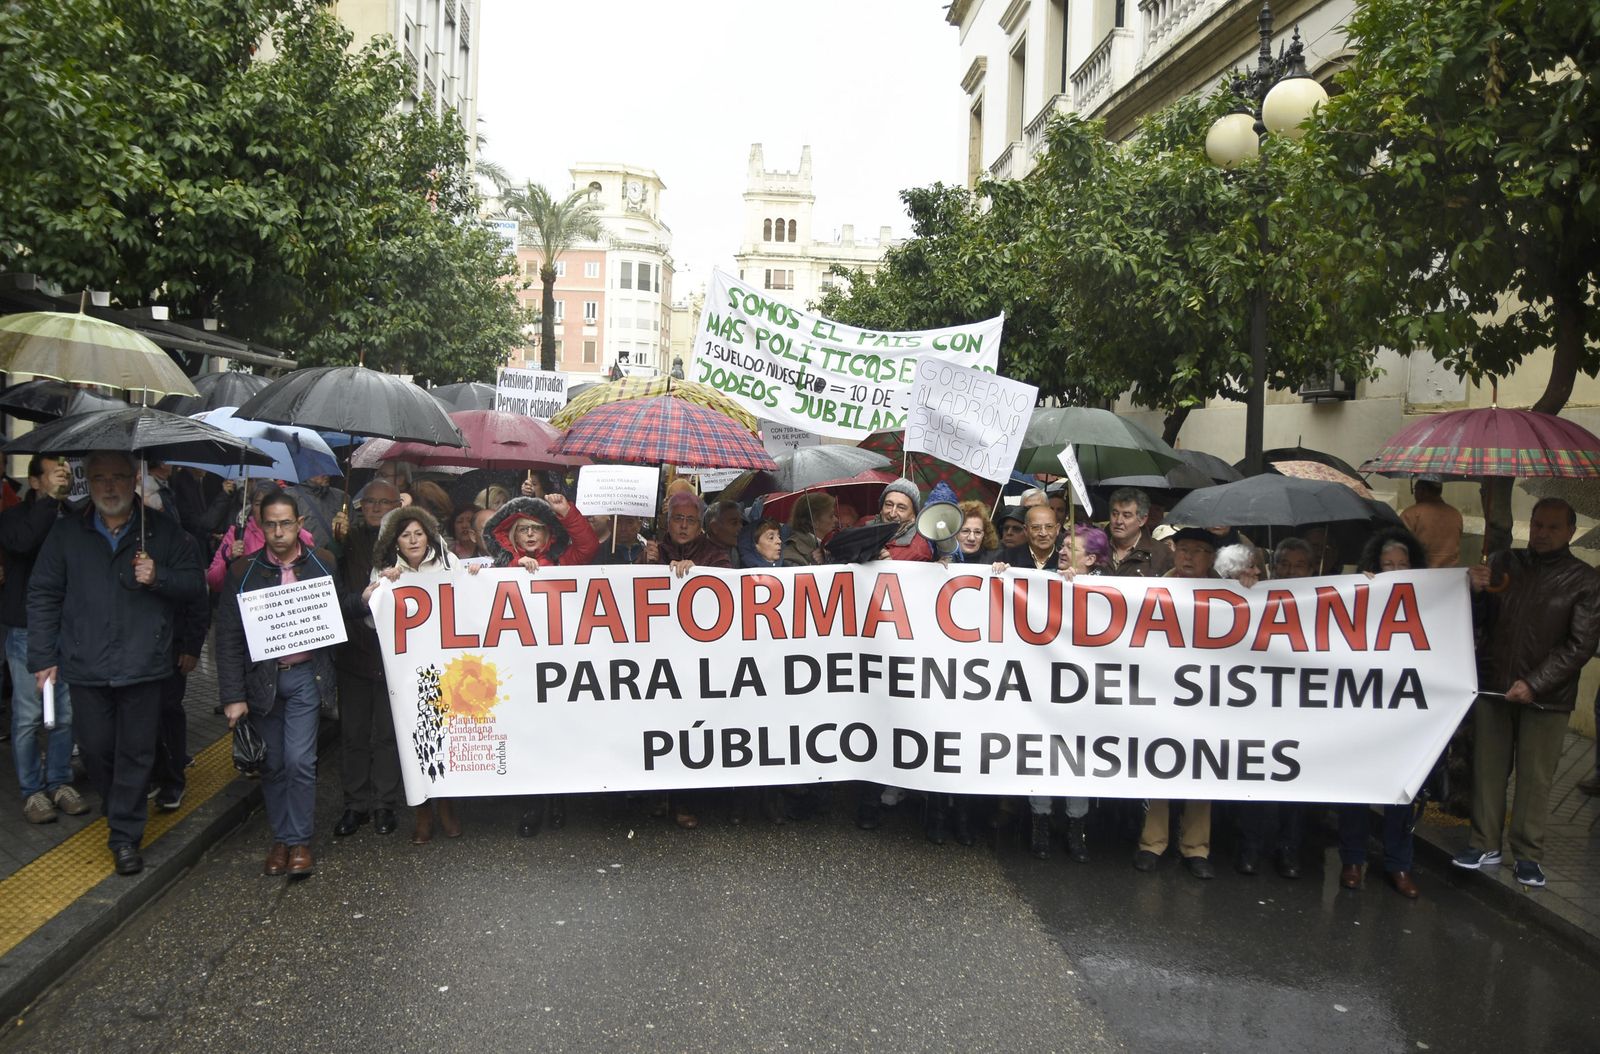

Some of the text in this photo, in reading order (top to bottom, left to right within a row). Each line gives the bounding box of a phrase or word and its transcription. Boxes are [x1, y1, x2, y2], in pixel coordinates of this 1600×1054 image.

[706, 311, 747, 344] MÁS
[728, 287, 983, 353] SOMOS EL PAIS CON
[498, 370, 564, 393] Pensiones privadas
[920, 360, 1029, 413] GOBIERNO
[497, 392, 561, 418] Personas estafadas
[850, 384, 868, 403] 10
[872, 388, 895, 408] DE
[914, 407, 1009, 454] SUBE LA
[242, 579, 333, 604] POR NEGLIGENCIA MÉDICA
[284, 597, 294, 605] DE
[296, 592, 320, 603] VISIÓN
[321, 590, 331, 598] EN
[257, 602, 328, 622] OJO LA SEGURIDAD
[391, 571, 1431, 655] PLATAFORMA CIUDADANA
[265, 624, 330, 643] HACE CARGO DEL
[270, 621, 298, 631] SOCIAL
[299, 617, 311, 625] NO
[264, 633, 336, 654] DAÑO OCASIONADO
[535, 652, 1429, 710] PARA LA DEFENSA DEL SISTEMA
[448, 724, 493, 734] Ciudadana
[449, 714, 497, 725] Plataforma
[448, 742, 493, 752] del Sistema
[450, 732, 508, 744] para la Defensa
[449, 750, 496, 761] Público de
[643, 720, 1301, 783] PÚBLICO DE PENSIONES
[449, 760, 496, 772] Pensiones
